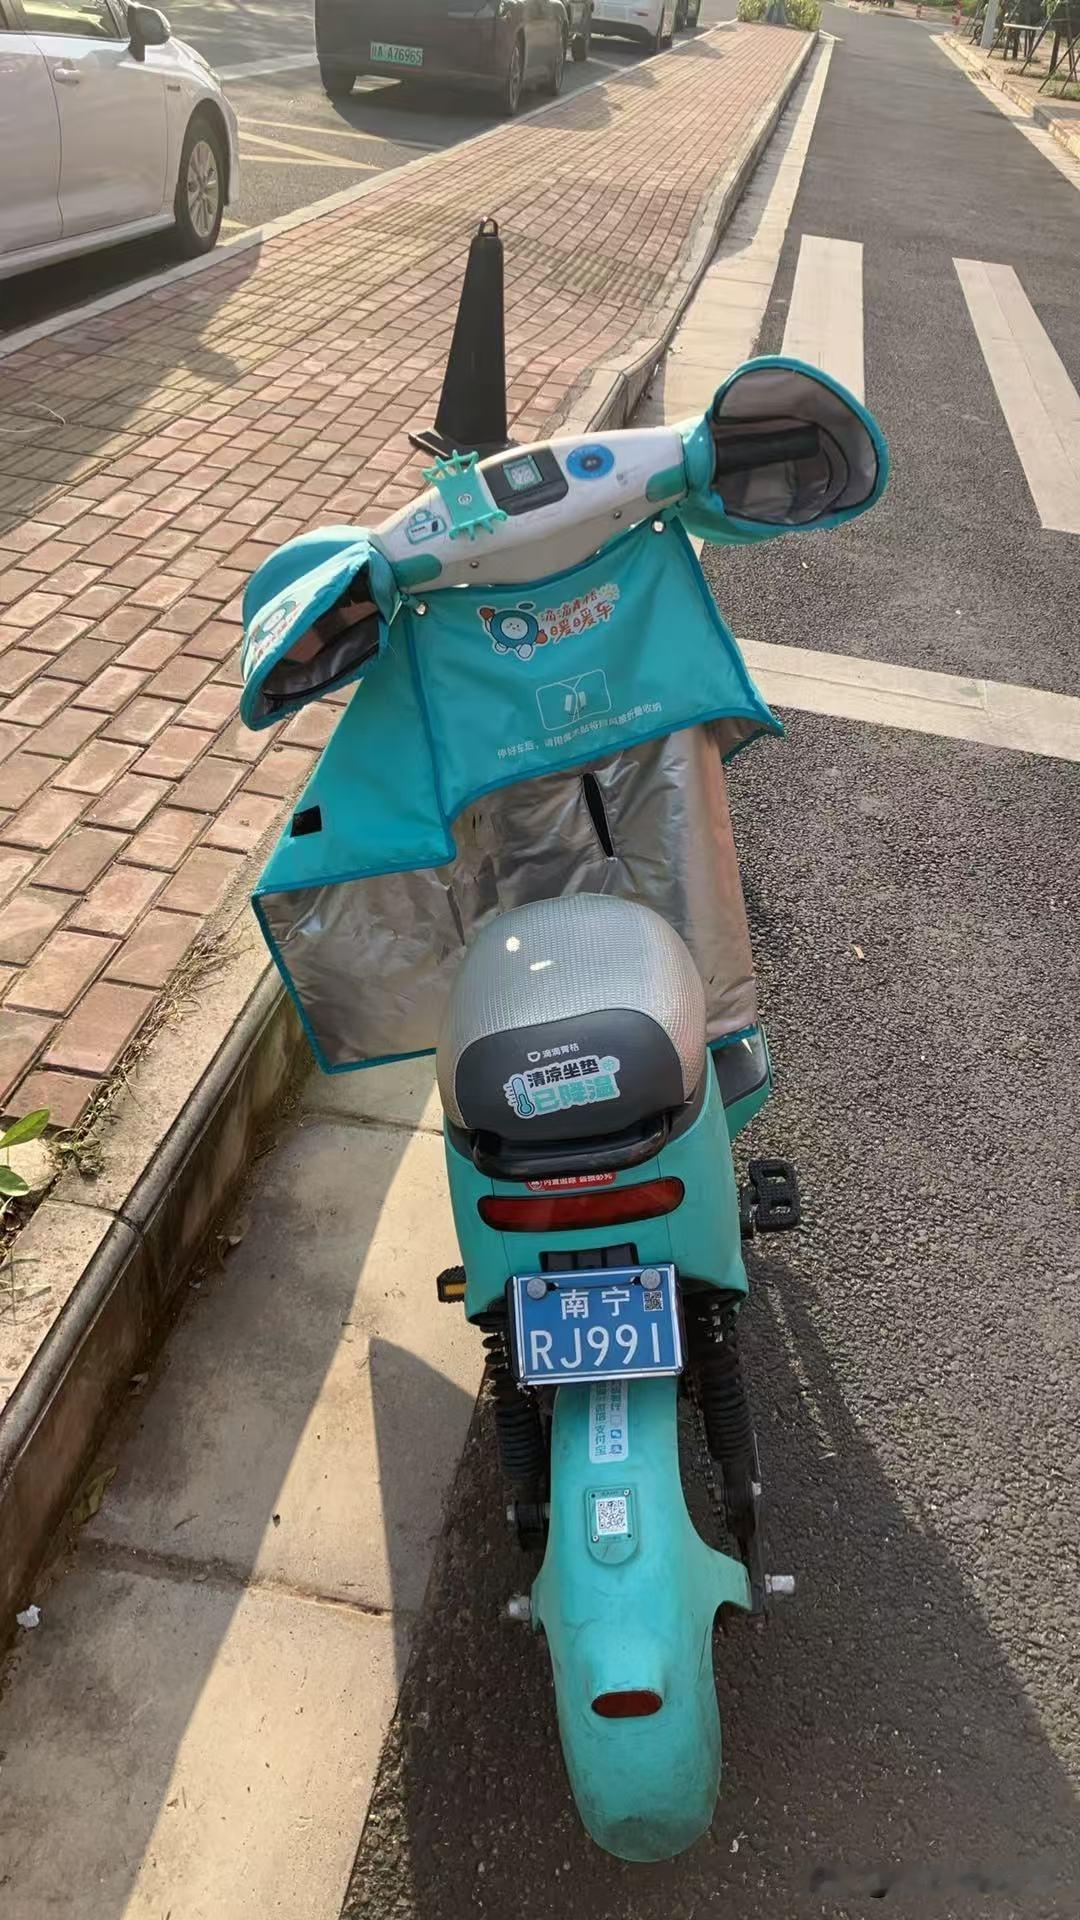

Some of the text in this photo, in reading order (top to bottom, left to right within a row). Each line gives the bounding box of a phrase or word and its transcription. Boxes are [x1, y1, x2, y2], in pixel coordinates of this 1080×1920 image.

[542, 1043, 579, 1059] 滴滴青桔
[527, 1059, 600, 1088] 清凉坐垫
[533, 1075, 614, 1112] 已降温
[560, 1286, 631, 1321] 南宁
[530, 1323, 661, 1371] RJ991
